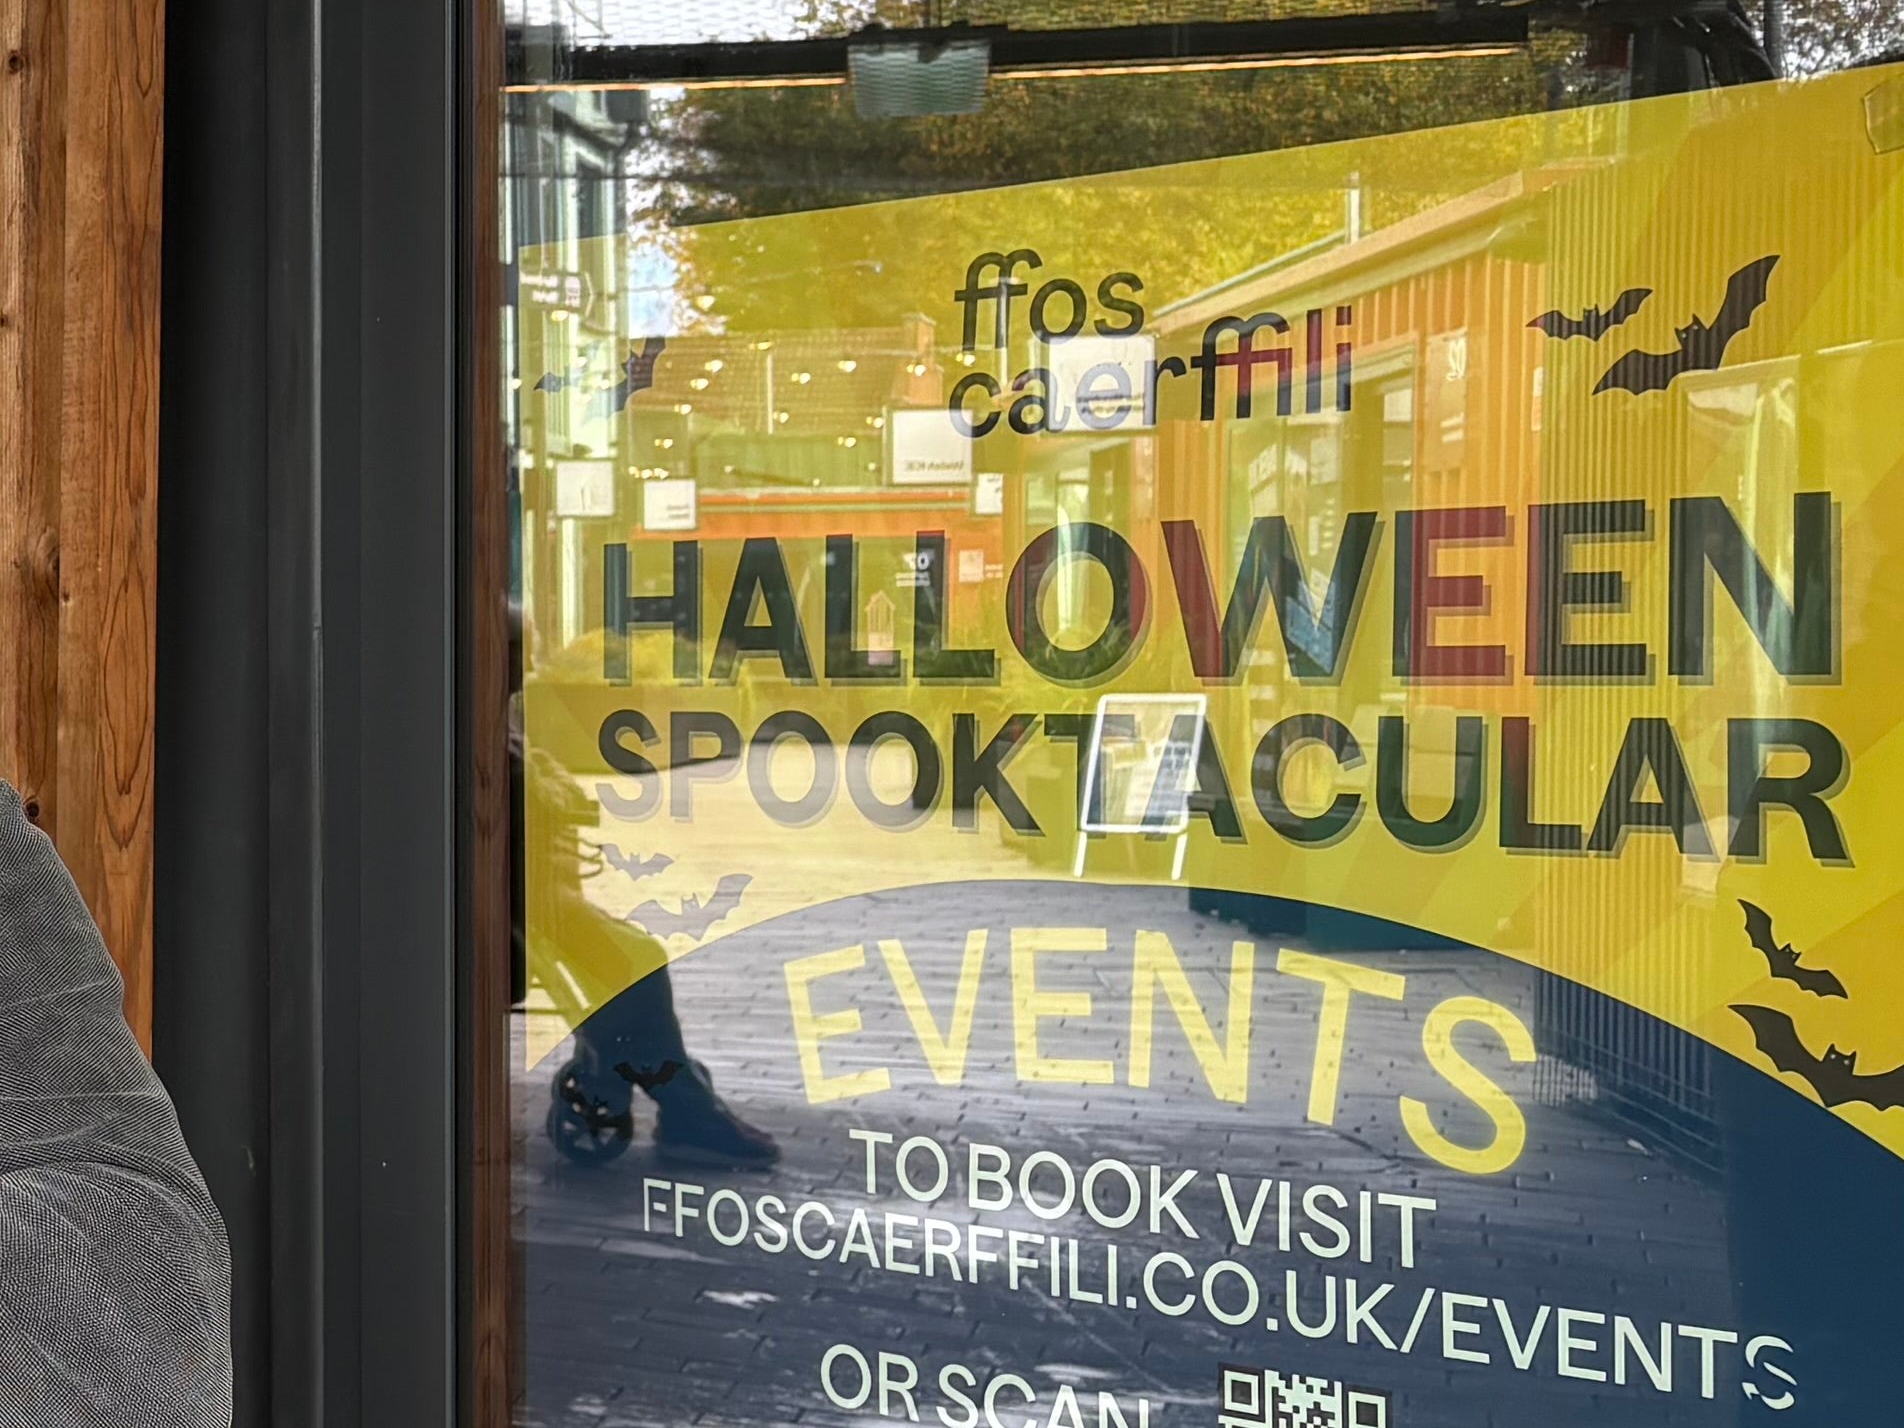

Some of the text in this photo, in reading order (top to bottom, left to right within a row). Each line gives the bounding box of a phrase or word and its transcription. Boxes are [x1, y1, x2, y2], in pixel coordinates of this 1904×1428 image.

[947, 305, 1355, 438] caerffili
[955, 248, 1145, 352] ffos
[600, 490, 1842, 689] HALLOWEEN
[596, 709, 1856, 868] SPOOKTACULAR
[784, 926, 1539, 1177] EVENTS
[849, 1128, 1438, 1269] TO BOOK VISIT
[641, 1176, 1798, 1412] FFOSCAERFFILI.CO.UK/EVENTS
[820, 1343, 920, 1422] OR
